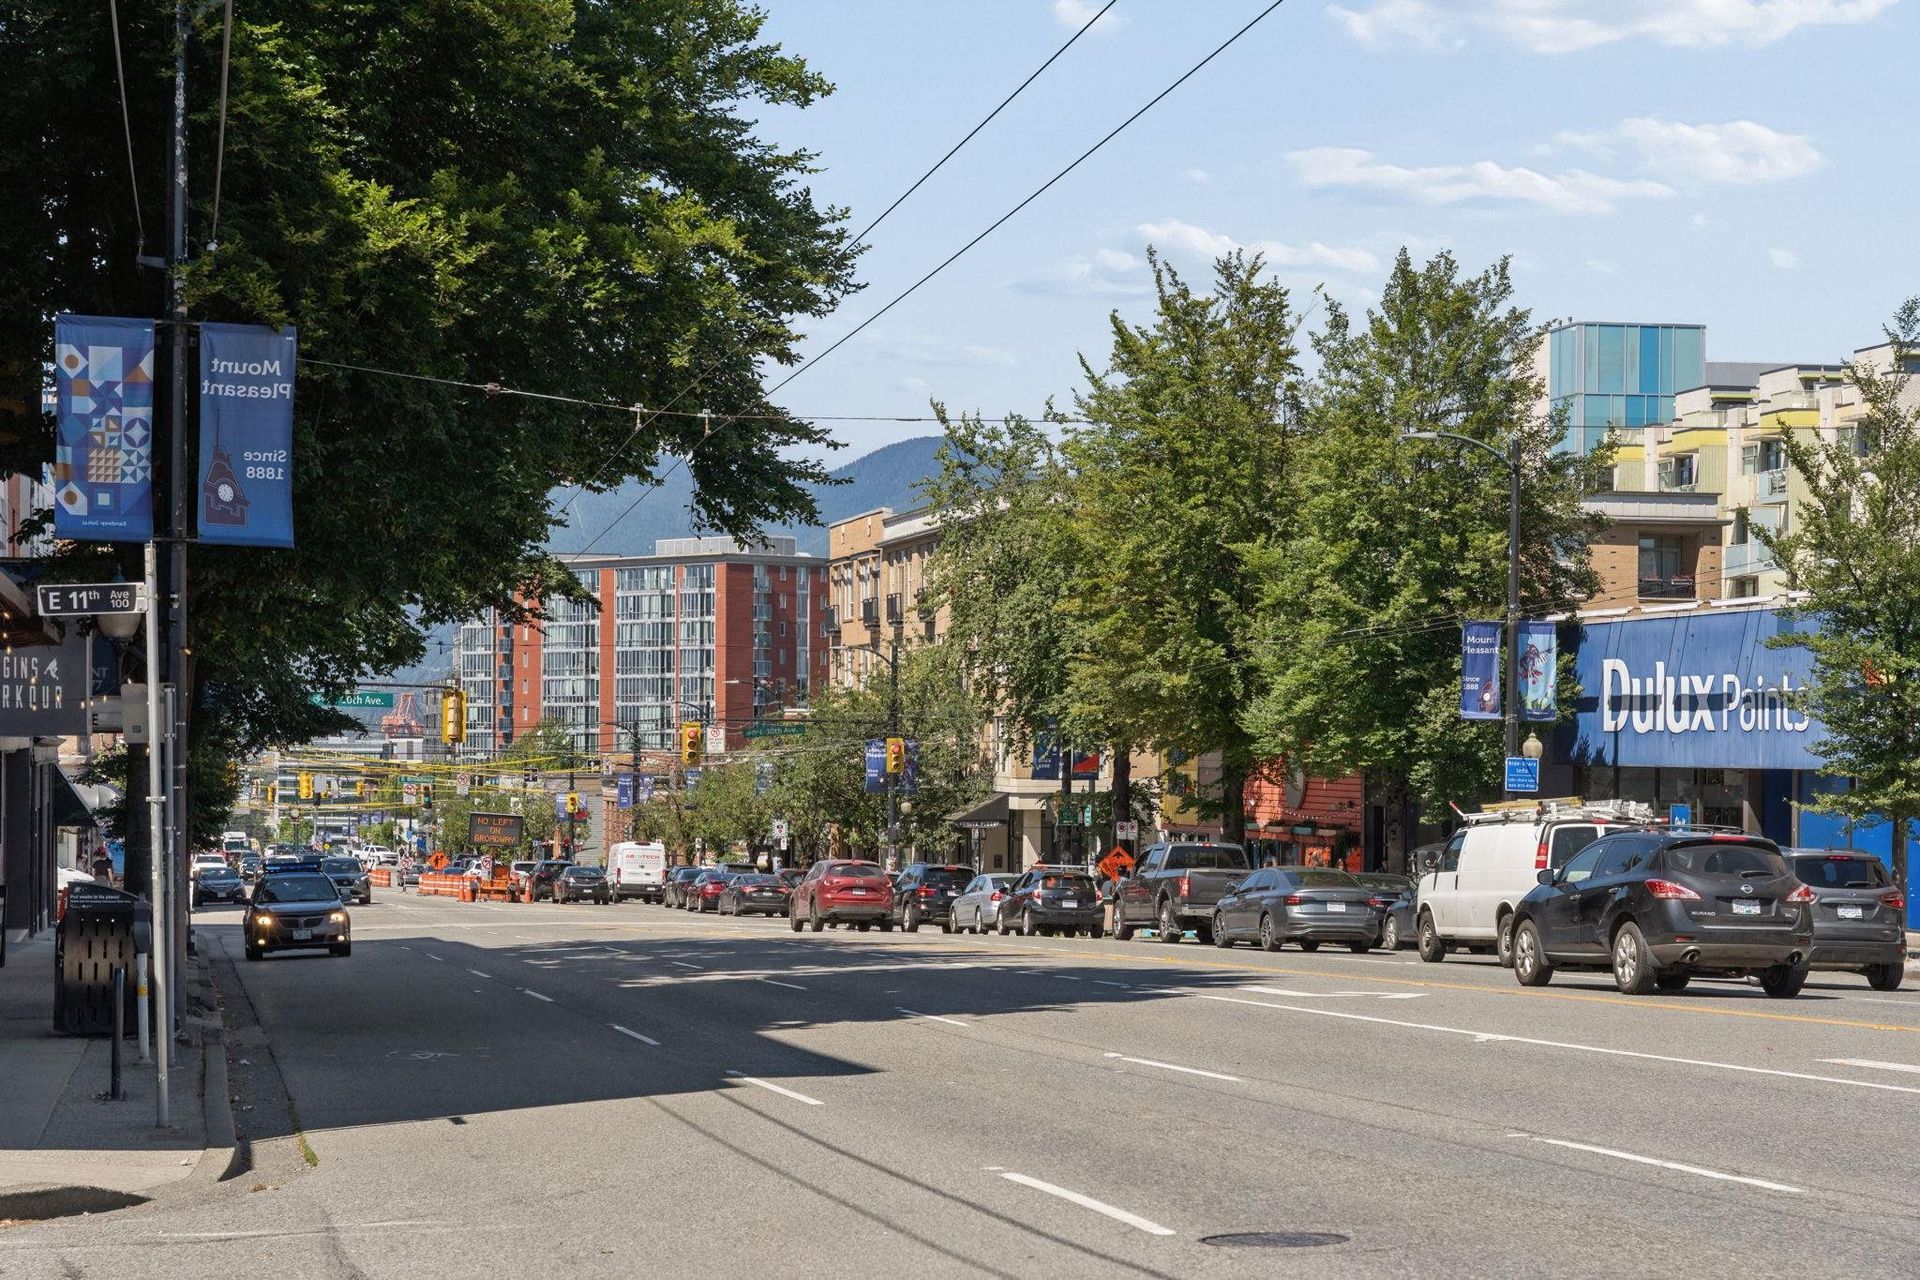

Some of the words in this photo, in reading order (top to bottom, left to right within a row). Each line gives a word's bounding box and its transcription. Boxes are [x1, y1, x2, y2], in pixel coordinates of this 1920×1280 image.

[49, 592, 61, 610] E
[69, 590, 100, 610] 11th
[110, 590, 130, 599] Ave
[110, 599, 130, 608] 100
[1466, 636, 1495, 644] Mount
[1462, 646, 1499, 654] Pleasant
[364, 695, 385, 705] Ave.
[1602, 658, 1715, 734] Dulux
[1722, 673, 1811, 732] Paints
[477, 817, 489, 825] NO
[493, 818, 513, 826] LEFT
[473, 834, 516, 844] BROADWAY
